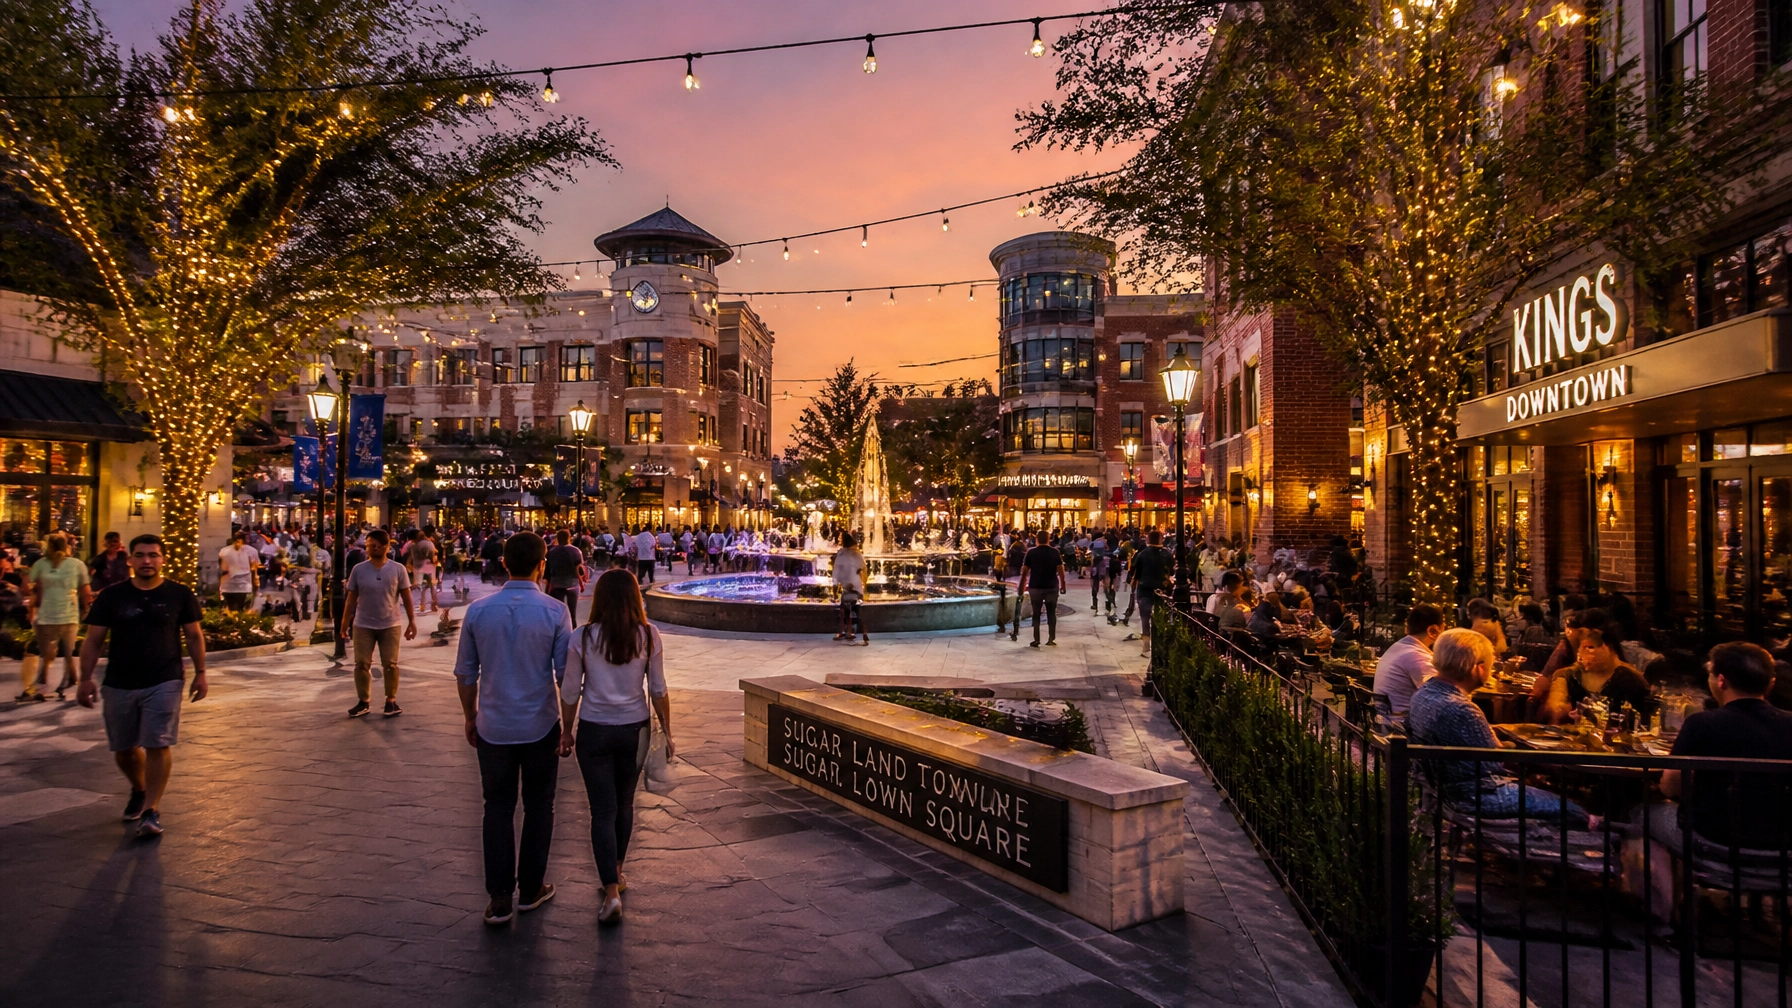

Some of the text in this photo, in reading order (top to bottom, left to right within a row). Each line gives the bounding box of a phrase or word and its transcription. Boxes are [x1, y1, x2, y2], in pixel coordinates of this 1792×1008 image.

[1513, 263, 1617, 374] KINGS
[1507, 364, 1628, 423] DOWNTOWN
[784, 716, 842, 758] SUGAR
[853, 740, 907, 781] LAND
[853, 771, 913, 818] LOWN
[926, 799, 1031, 869] SQUARE
